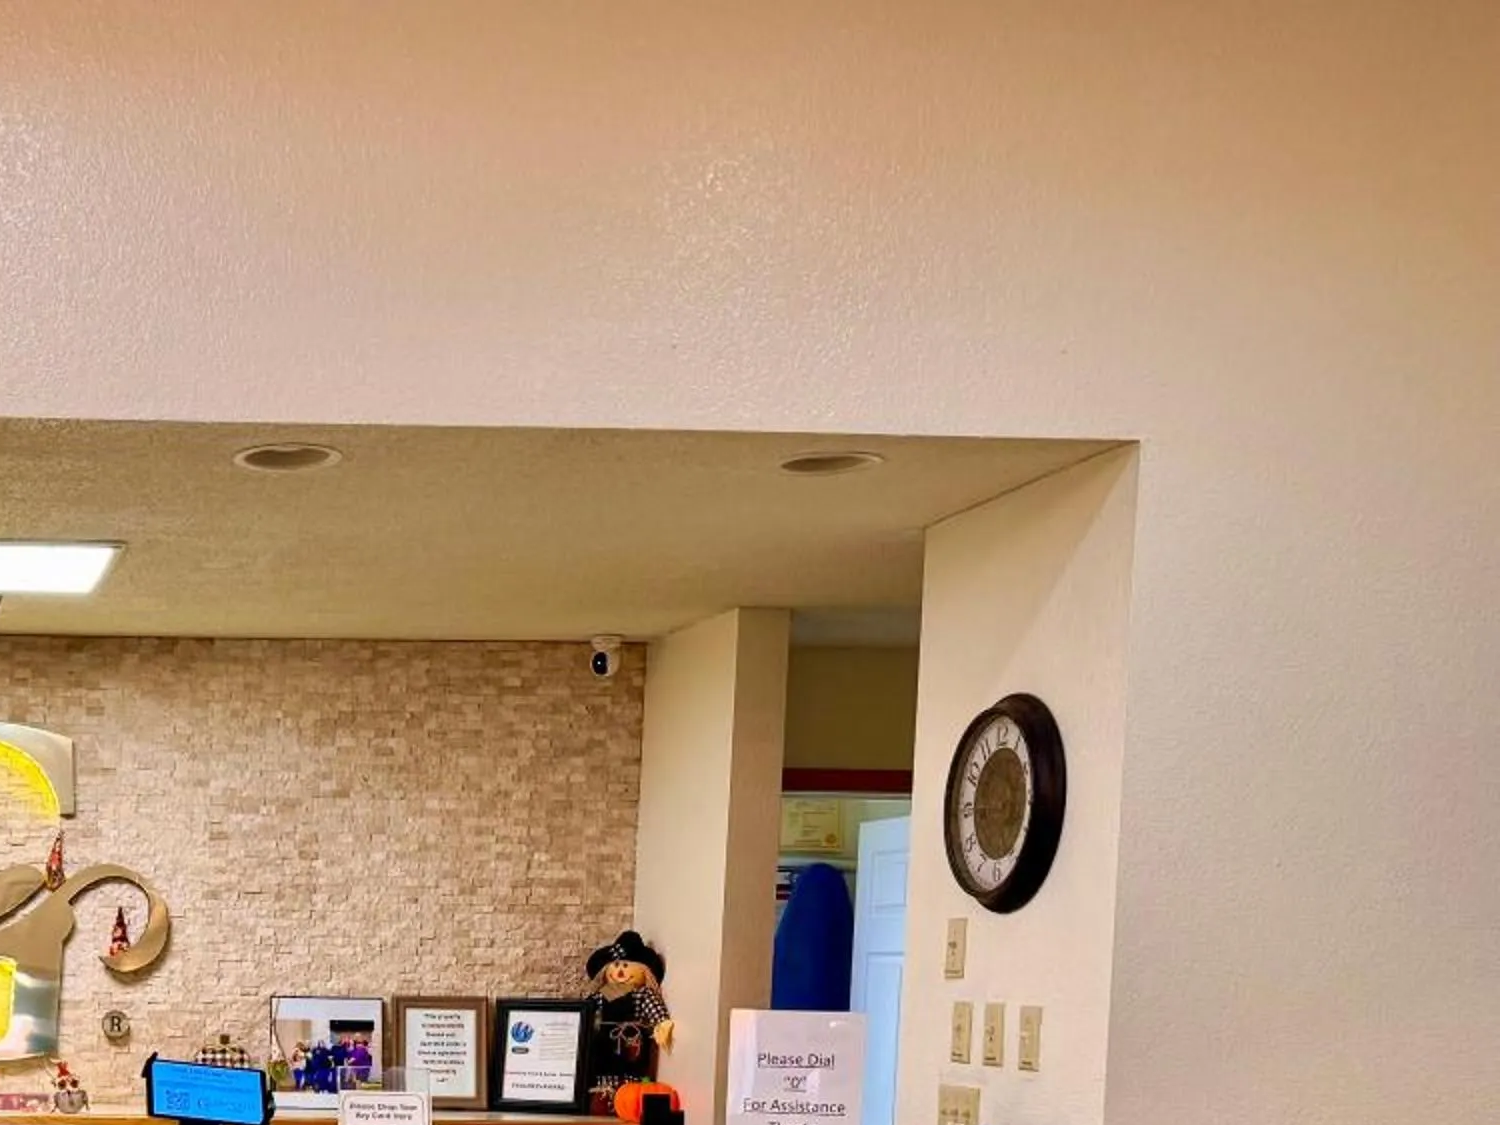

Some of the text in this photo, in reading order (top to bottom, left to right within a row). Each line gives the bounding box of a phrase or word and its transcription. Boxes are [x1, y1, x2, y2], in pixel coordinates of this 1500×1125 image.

[998, 723, 1009, 747] 12
[757, 1051, 835, 1069] Please Dial
[743, 1098, 846, 1115] For Assistance
